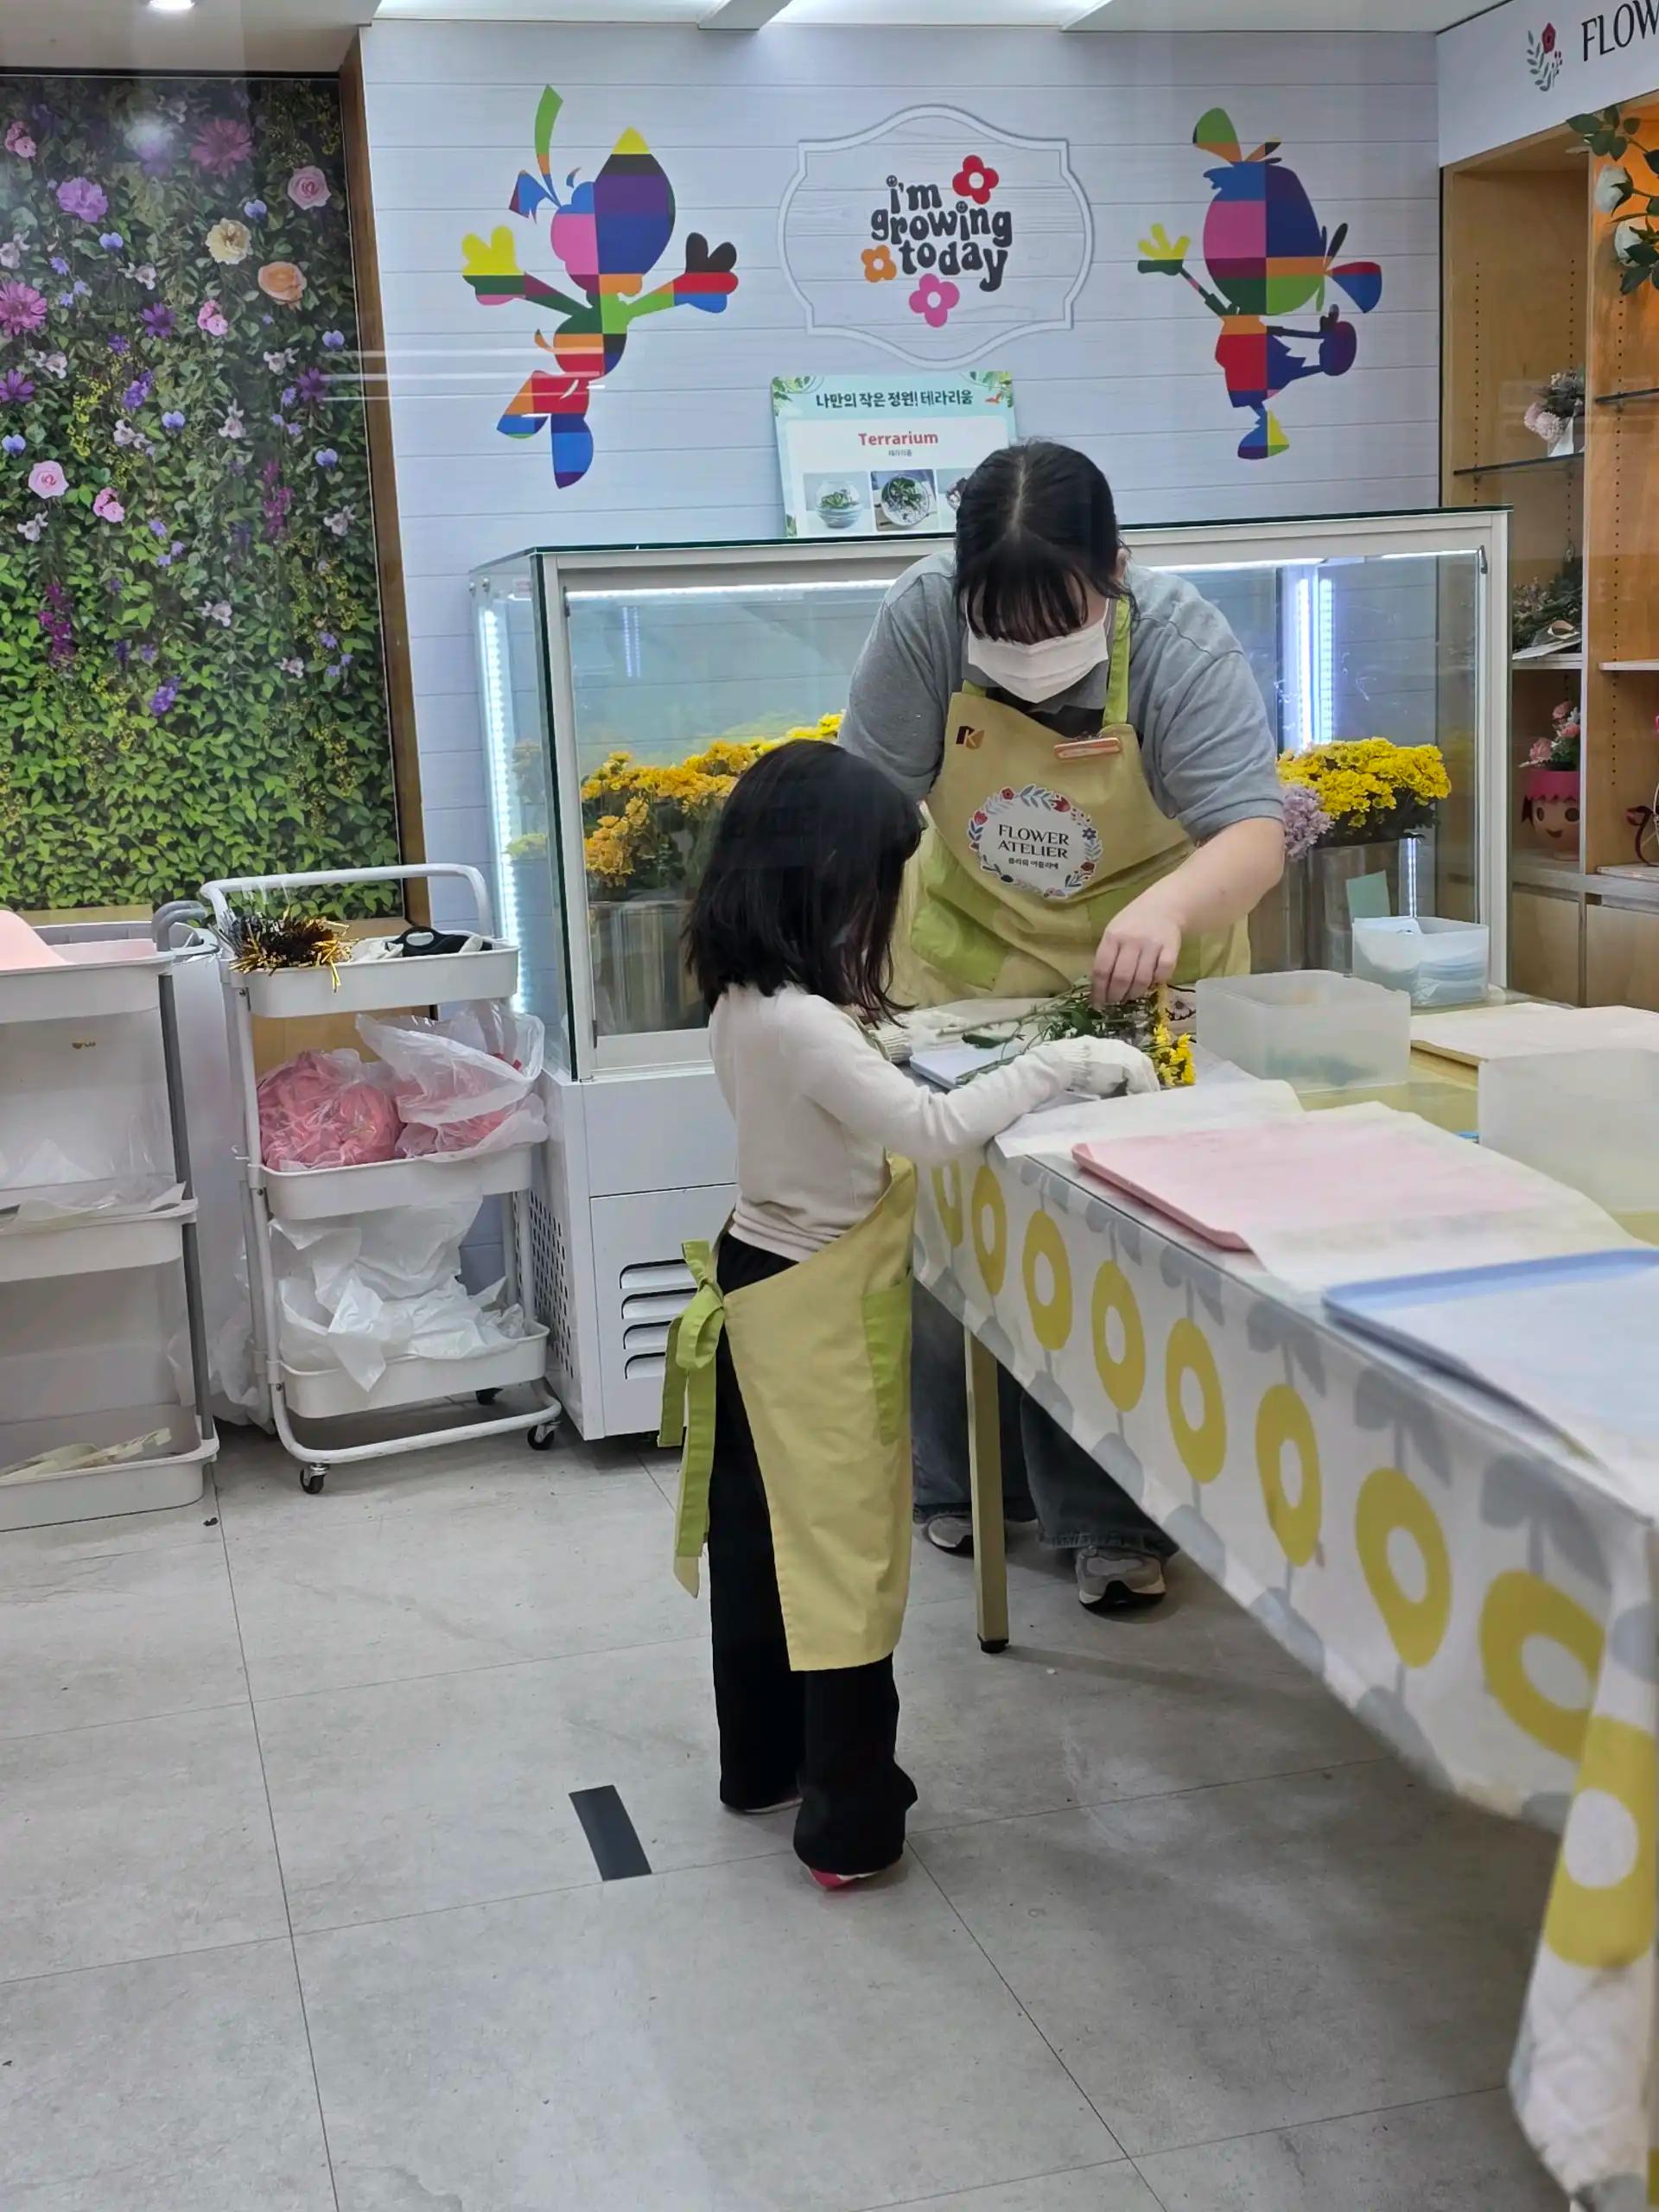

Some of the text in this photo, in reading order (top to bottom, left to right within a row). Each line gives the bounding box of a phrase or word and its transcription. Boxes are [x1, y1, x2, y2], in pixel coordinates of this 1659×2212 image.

[886, 175, 943, 213] i'm
[871, 200, 1013, 248] growing
[899, 239, 1008, 292] today
[816, 389, 973, 409] 나만의 작은 정원! 테라리움
[858, 430, 938, 446] Terrarium
[998, 823, 1070, 846] FLOWER
[997, 840, 1069, 860] ATELIER
